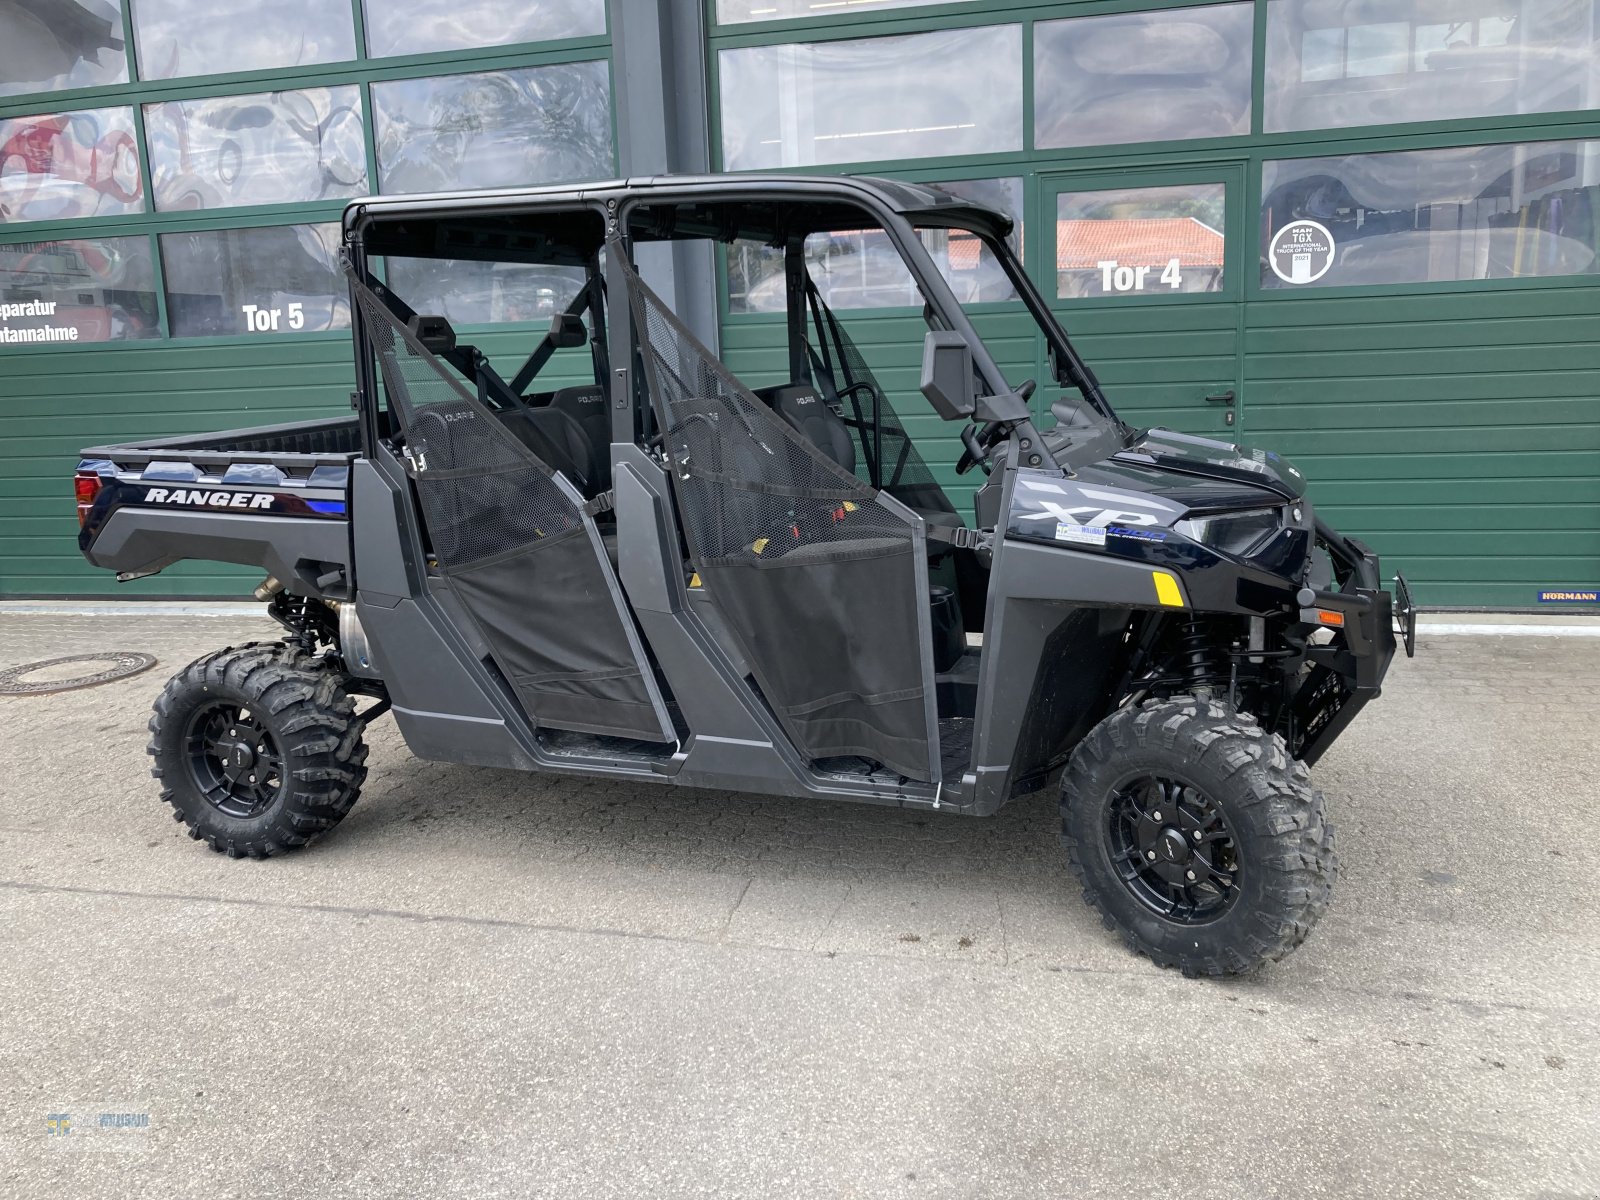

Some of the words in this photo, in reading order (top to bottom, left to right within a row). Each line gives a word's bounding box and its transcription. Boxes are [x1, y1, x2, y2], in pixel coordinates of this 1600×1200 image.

[1292, 233, 1312, 242] TGX
[1097, 260, 1151, 292] Tor
[1160, 258, 1182, 289] 4
[0, 299, 57, 321] paratur
[242, 304, 281, 332] Tor
[288, 303, 304, 329] 5
[144, 488, 275, 509] RANGER
[1017, 501, 1159, 528] XP
[1107, 526, 1168, 539] 1000
